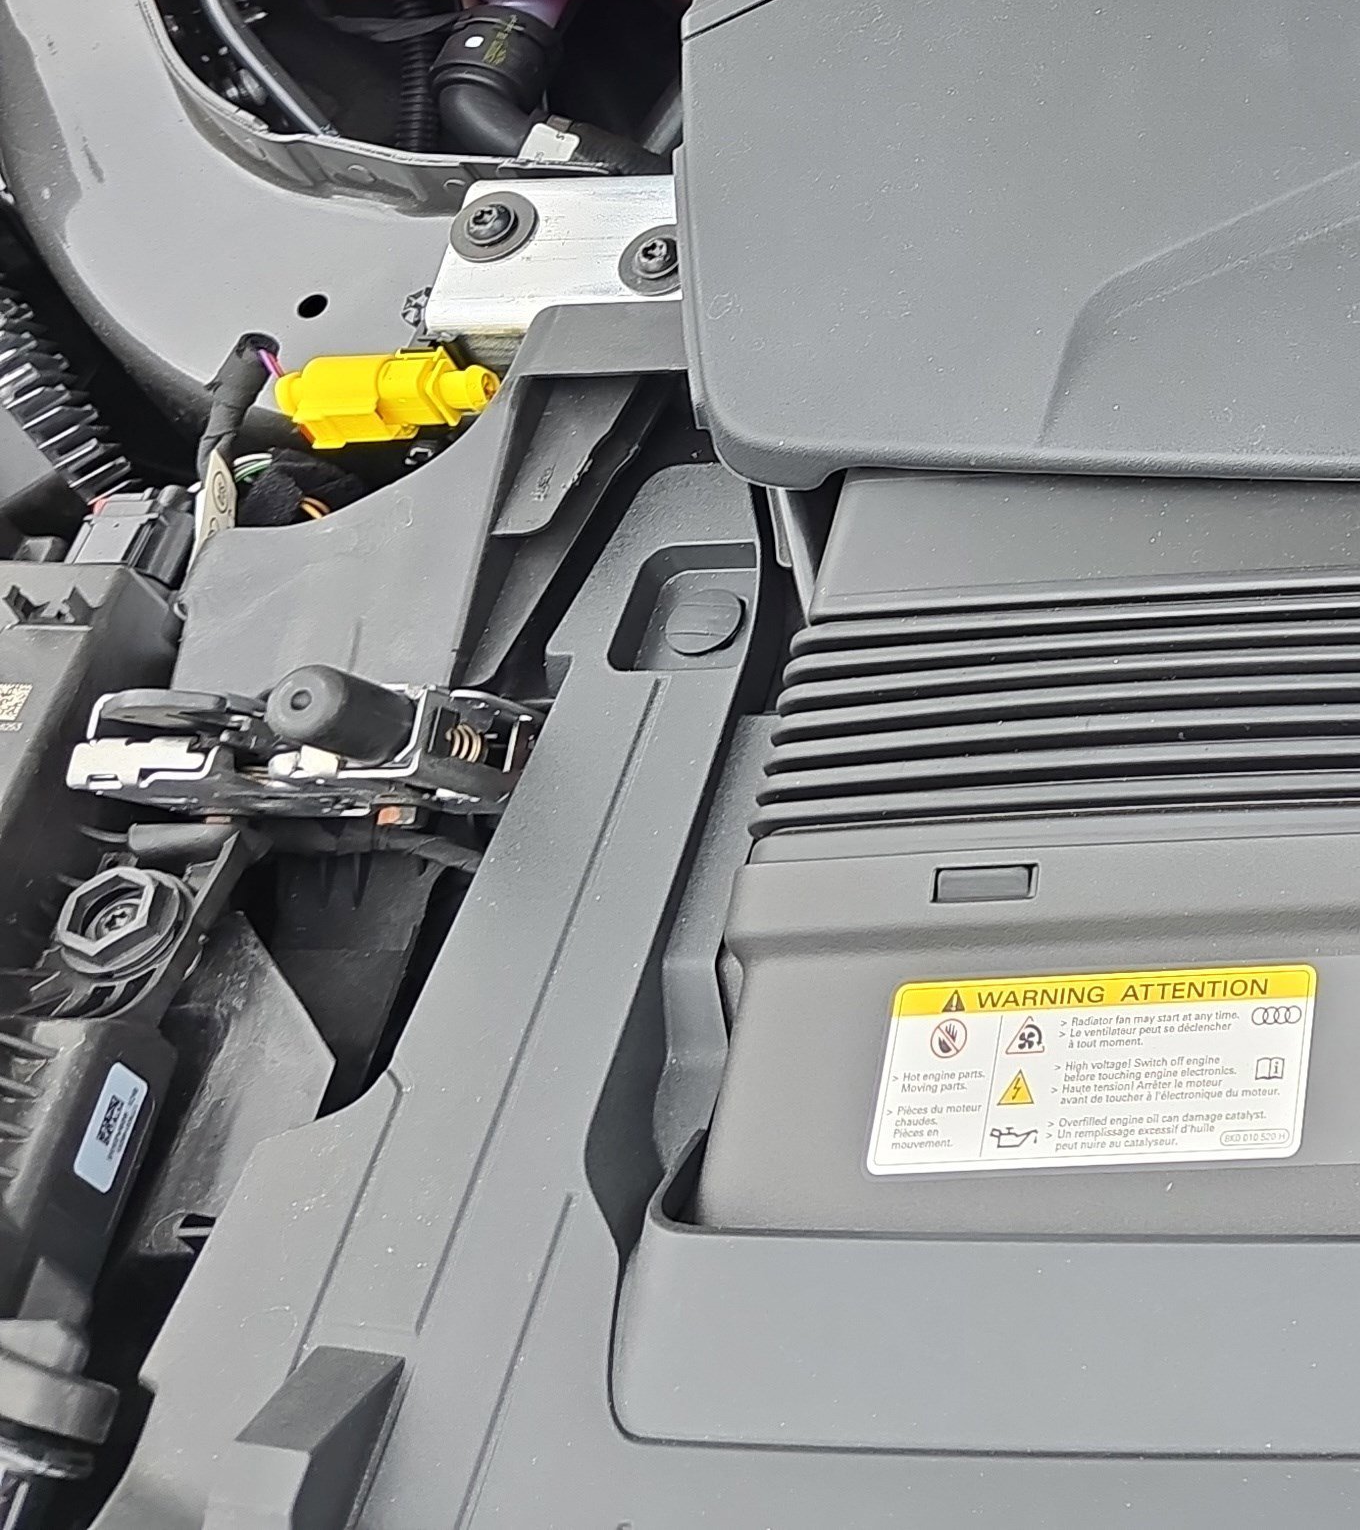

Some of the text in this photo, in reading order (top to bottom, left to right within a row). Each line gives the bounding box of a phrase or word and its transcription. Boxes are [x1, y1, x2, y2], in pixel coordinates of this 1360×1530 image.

[977, 979, 1268, 1008] WARNING ATTENTION
[1071, 1016, 1114, 1027] Radiator
[1115, 1015, 1131, 1025] fan
[1134, 1015, 1155, 1027] may
[1157, 1013, 1180, 1023] start
[1182, 1013, 1192, 1022] at
[1194, 1013, 1213, 1023] any
[1069, 1028, 1081, 1038] Le
[1139, 1026, 1161, 1036] peut
[1076, 1038, 1097, 1048] tout
[1065, 1061, 1088, 1073] High
[1133, 1057, 1168, 1068] Switch
[1170, 1056, 1184, 1066] off
[1186, 1056, 1220, 1067] engine
[903, 1072, 920, 1082] Hot
[922, 1071, 956, 1082] engine
[1063, 1071, 1097, 1082] before
[1098, 1069, 1142, 1082] touching
[1144, 1068, 1178, 1080] engine
[901, 1083, 938, 1093] Moving
[1062, 1083, 1091, 1095] Haute
[1185, 1078, 1223, 1088] moteur
[1060, 1095, 1088, 1105] avant
[1090, 1094, 1103, 1103] de
[1105, 1092, 1143, 1103] toucher
[1225, 1088, 1239, 1098] du
[931, 1104, 943, 1114] du
[946, 1104, 982, 1113] moteur
[1058, 1115, 1107, 1128] Overfilled
[1110, 1115, 1144, 1128] engine
[1146, 1114, 1160, 1124] oil
[1161, 1114, 1179, 1124] can
[1181, 1112, 1223, 1124] damage
[1057, 1129, 1072, 1139] Un
[1055, 1141, 1077, 1152] peut
[1080, 1139, 1106, 1149] nuire
[1109, 1139, 1122, 1148] au
